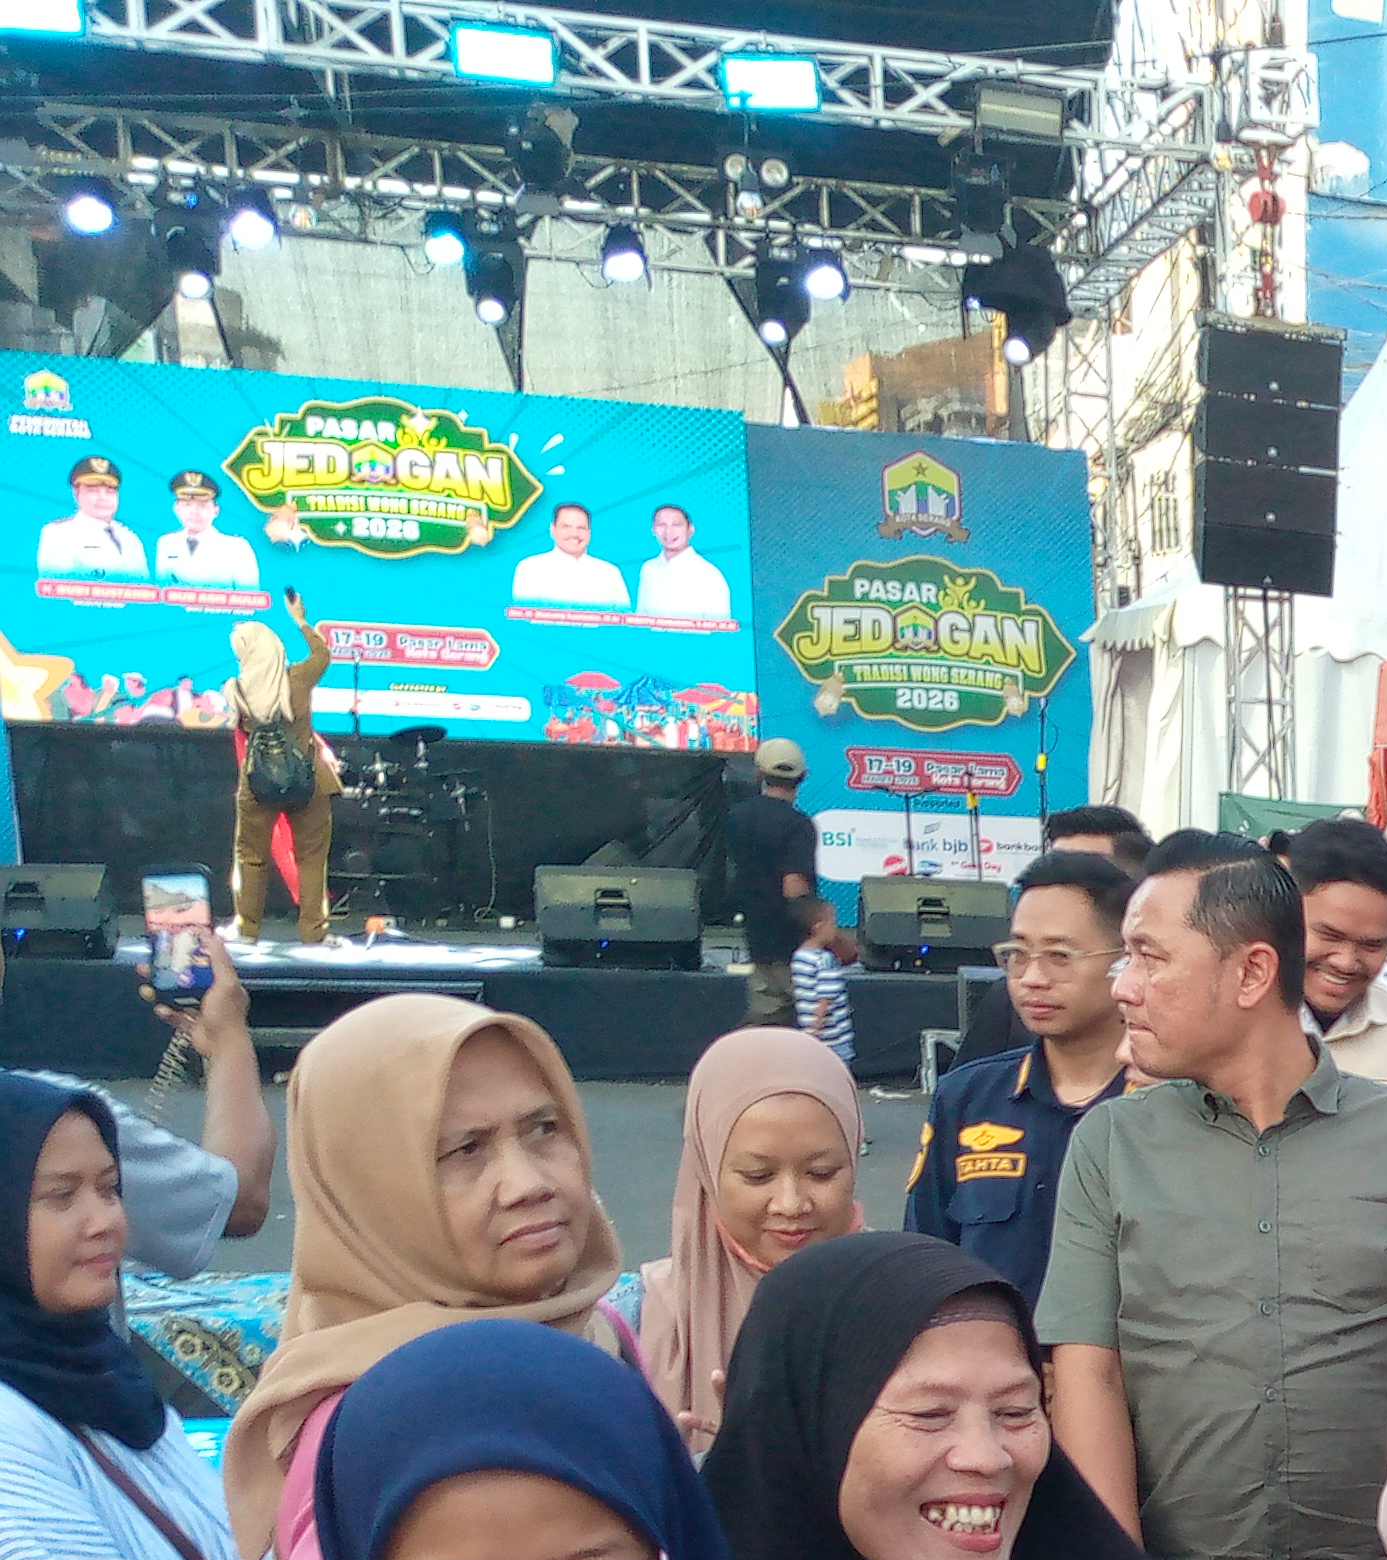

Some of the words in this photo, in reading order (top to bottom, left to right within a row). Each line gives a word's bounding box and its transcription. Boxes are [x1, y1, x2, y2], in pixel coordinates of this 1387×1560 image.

[306, 415, 397, 443] PASAR
[853, 577, 938, 604] PASAR
[852, 664, 908, 682] TRADISI
[909, 666, 949, 684] WONG
[950, 667, 1003, 690] SERANG
[896, 688, 960, 711] 2026
[865, 756, 914, 774] 17-19
[821, 832, 853, 847] BSI
[943, 838, 968, 854] bjb
